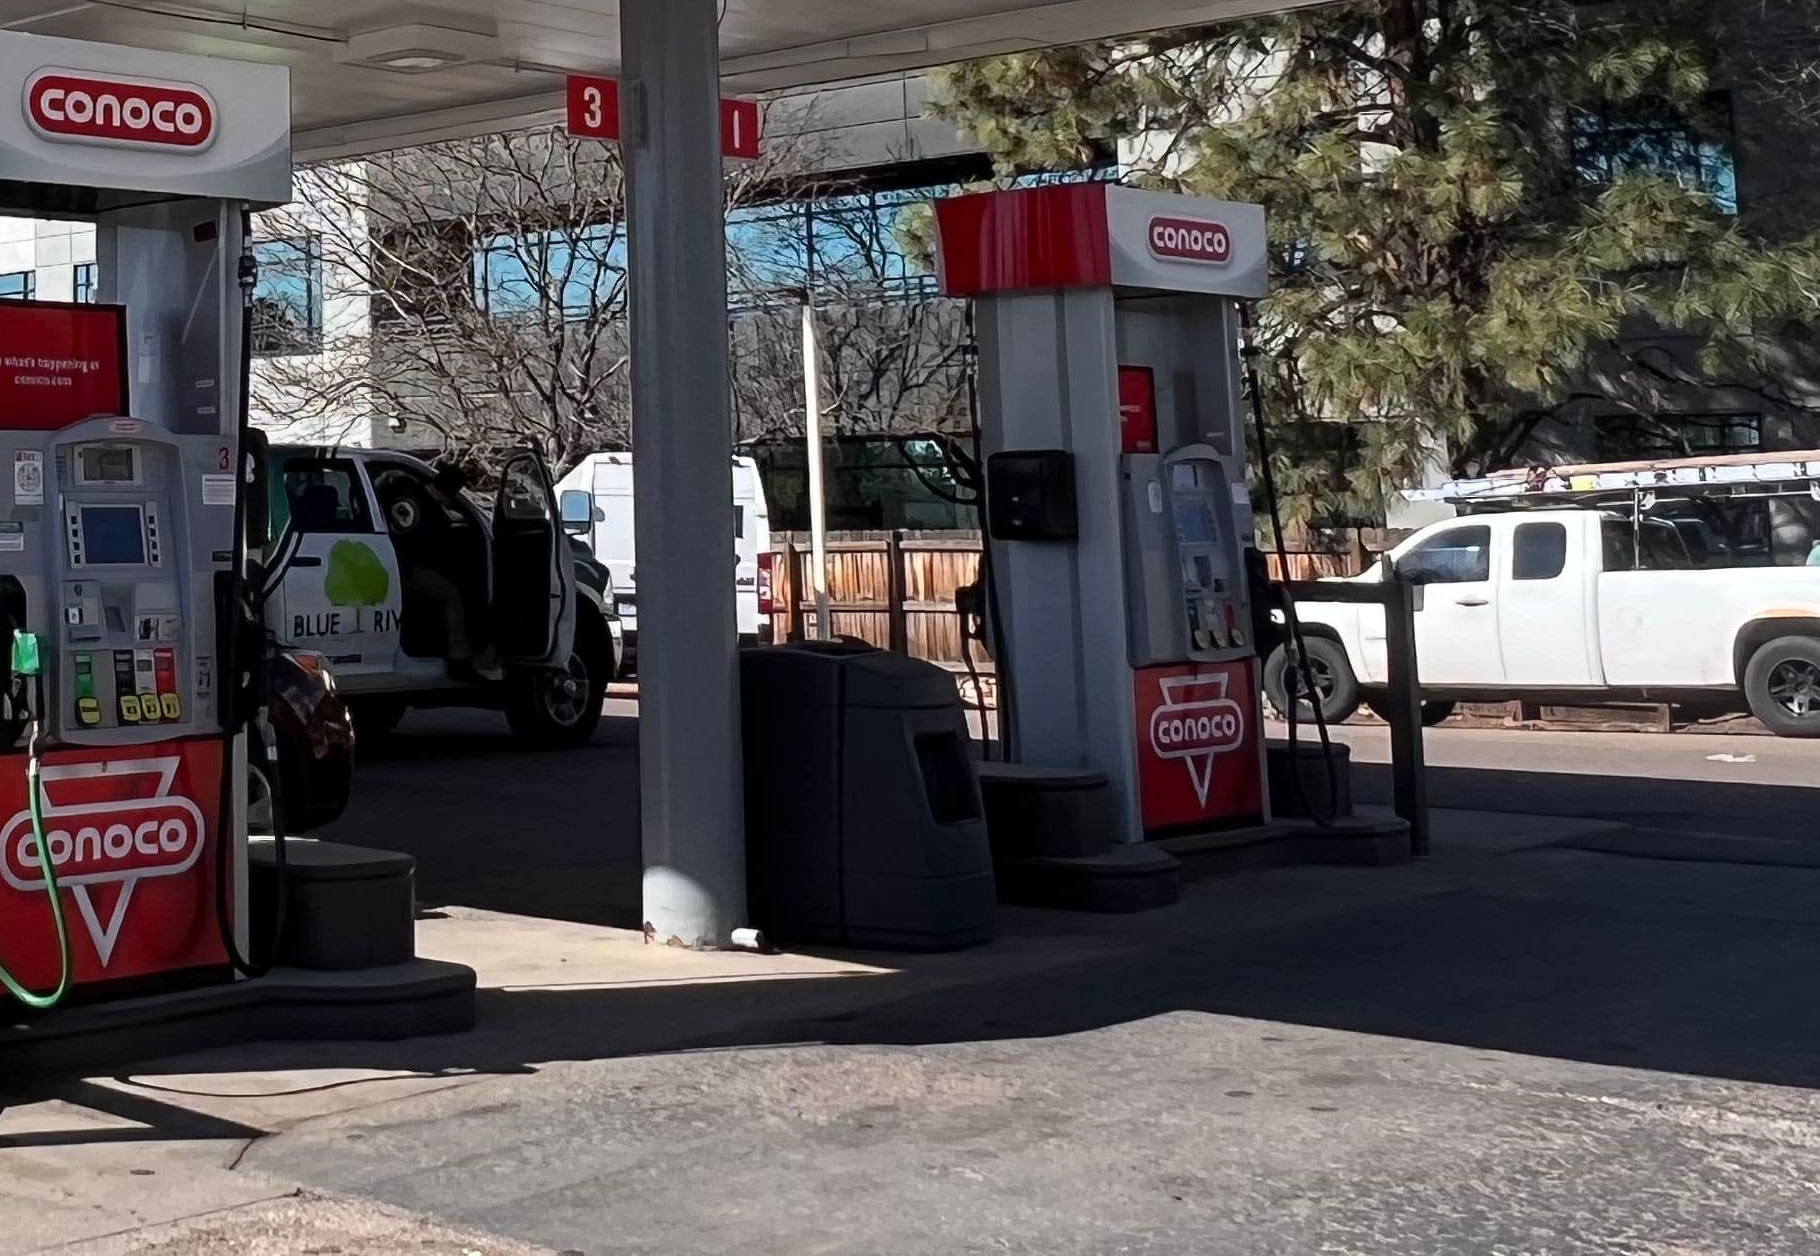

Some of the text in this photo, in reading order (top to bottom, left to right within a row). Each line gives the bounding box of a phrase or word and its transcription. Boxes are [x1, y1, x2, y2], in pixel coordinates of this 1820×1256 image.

[583, 86, 602, 128] 3
[732, 109, 741, 149] 1
[219, 447, 229, 471] 3
[294, 613, 341, 637] BLUE
